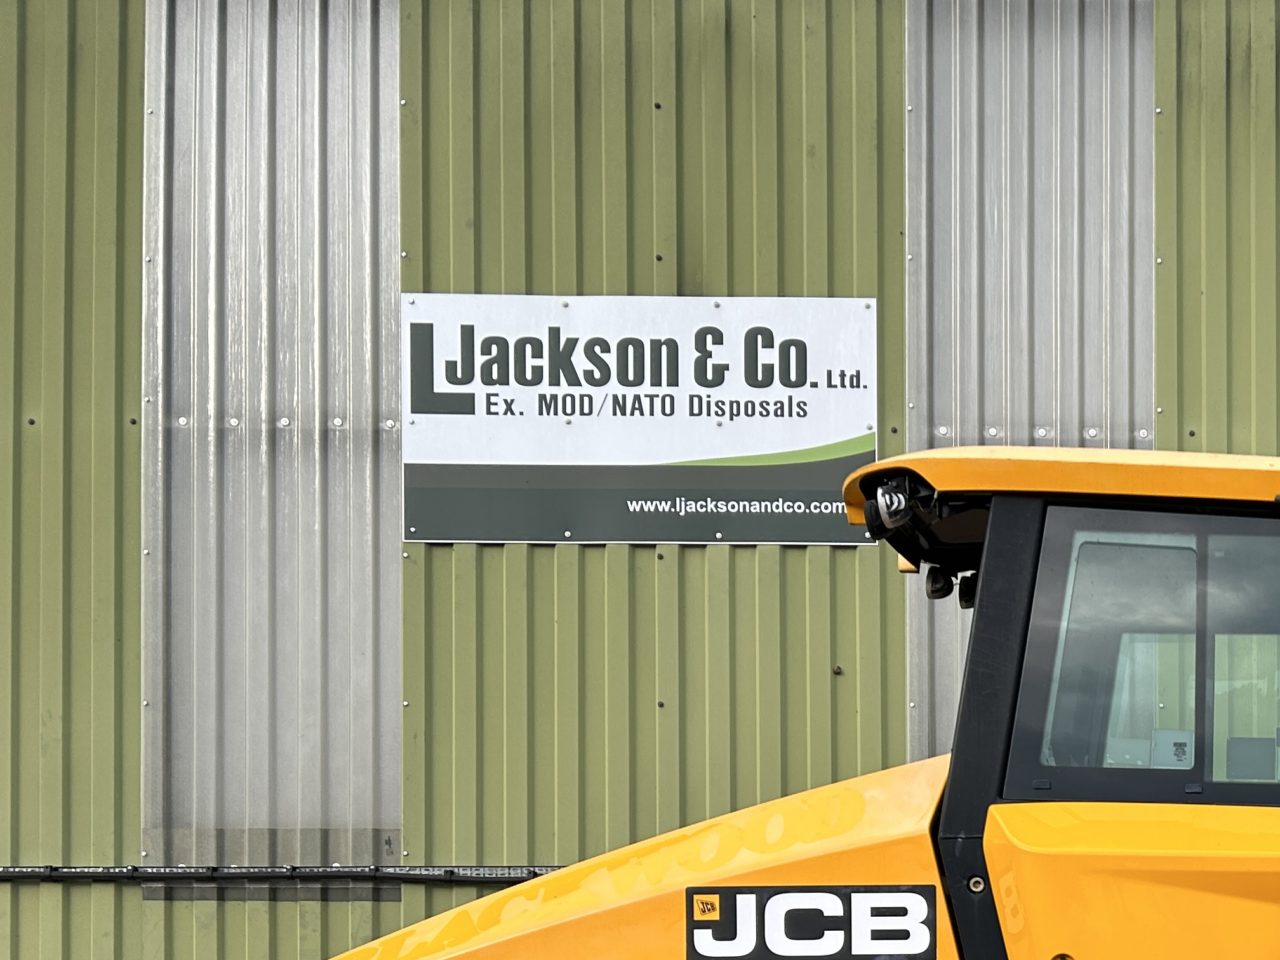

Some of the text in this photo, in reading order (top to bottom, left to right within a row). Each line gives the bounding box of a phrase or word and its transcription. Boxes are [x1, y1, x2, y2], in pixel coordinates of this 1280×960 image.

[694, 326, 729, 388] &
[744, 326, 818, 389] Co.
[826, 369, 868, 389] Ltd.
[485, 393, 808, 421] Ex. MOD/NATO Disposals
[627, 497, 848, 516] www.ljacksonandco.com
[700, 901, 716, 914] JCB
[693, 892, 931, 957] JCB
